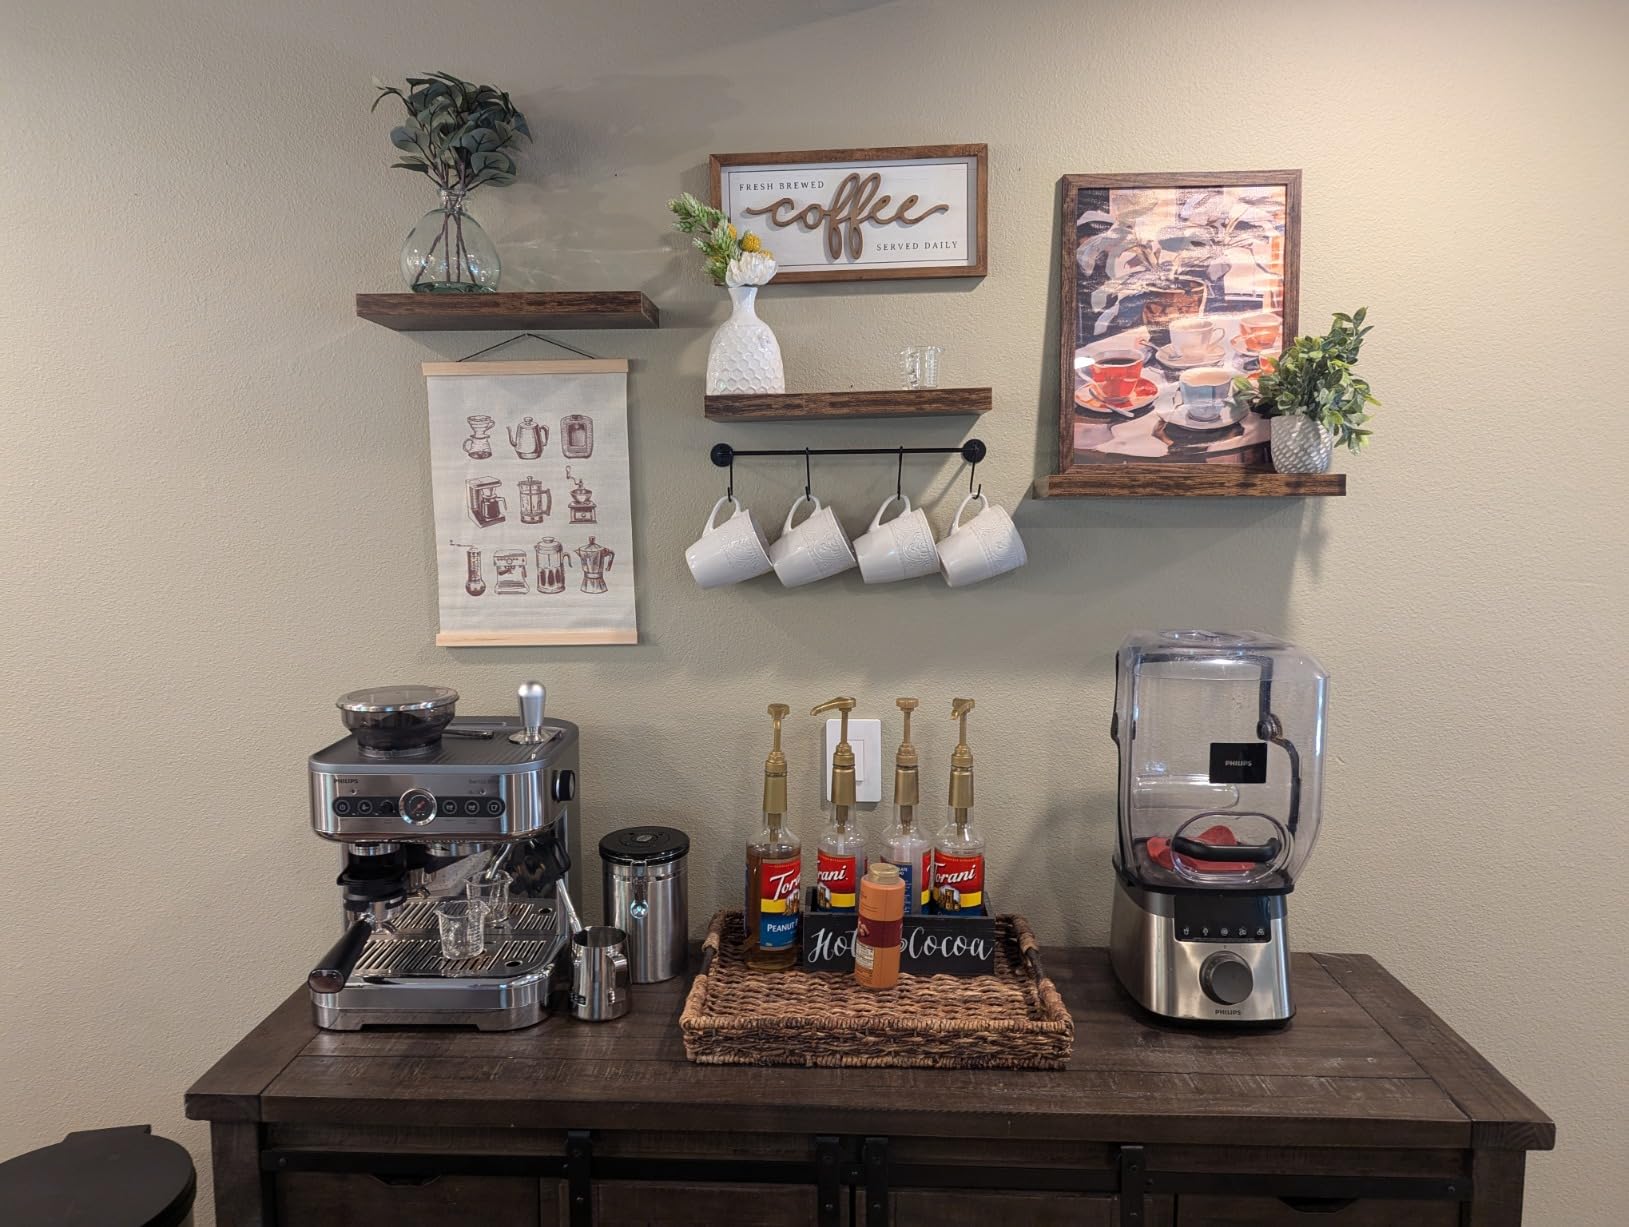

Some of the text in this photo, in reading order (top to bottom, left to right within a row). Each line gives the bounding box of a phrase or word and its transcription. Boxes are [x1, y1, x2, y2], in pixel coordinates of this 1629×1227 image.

[739, 180, 825, 191] FRESH BREWED
[745, 172, 949, 260] coffee
[876, 241, 959, 251] SERVED DAILY
[770, 868, 800, 902] Tor
[817, 864, 849, 882] rani
[909, 926, 993, 961] Cocoa
